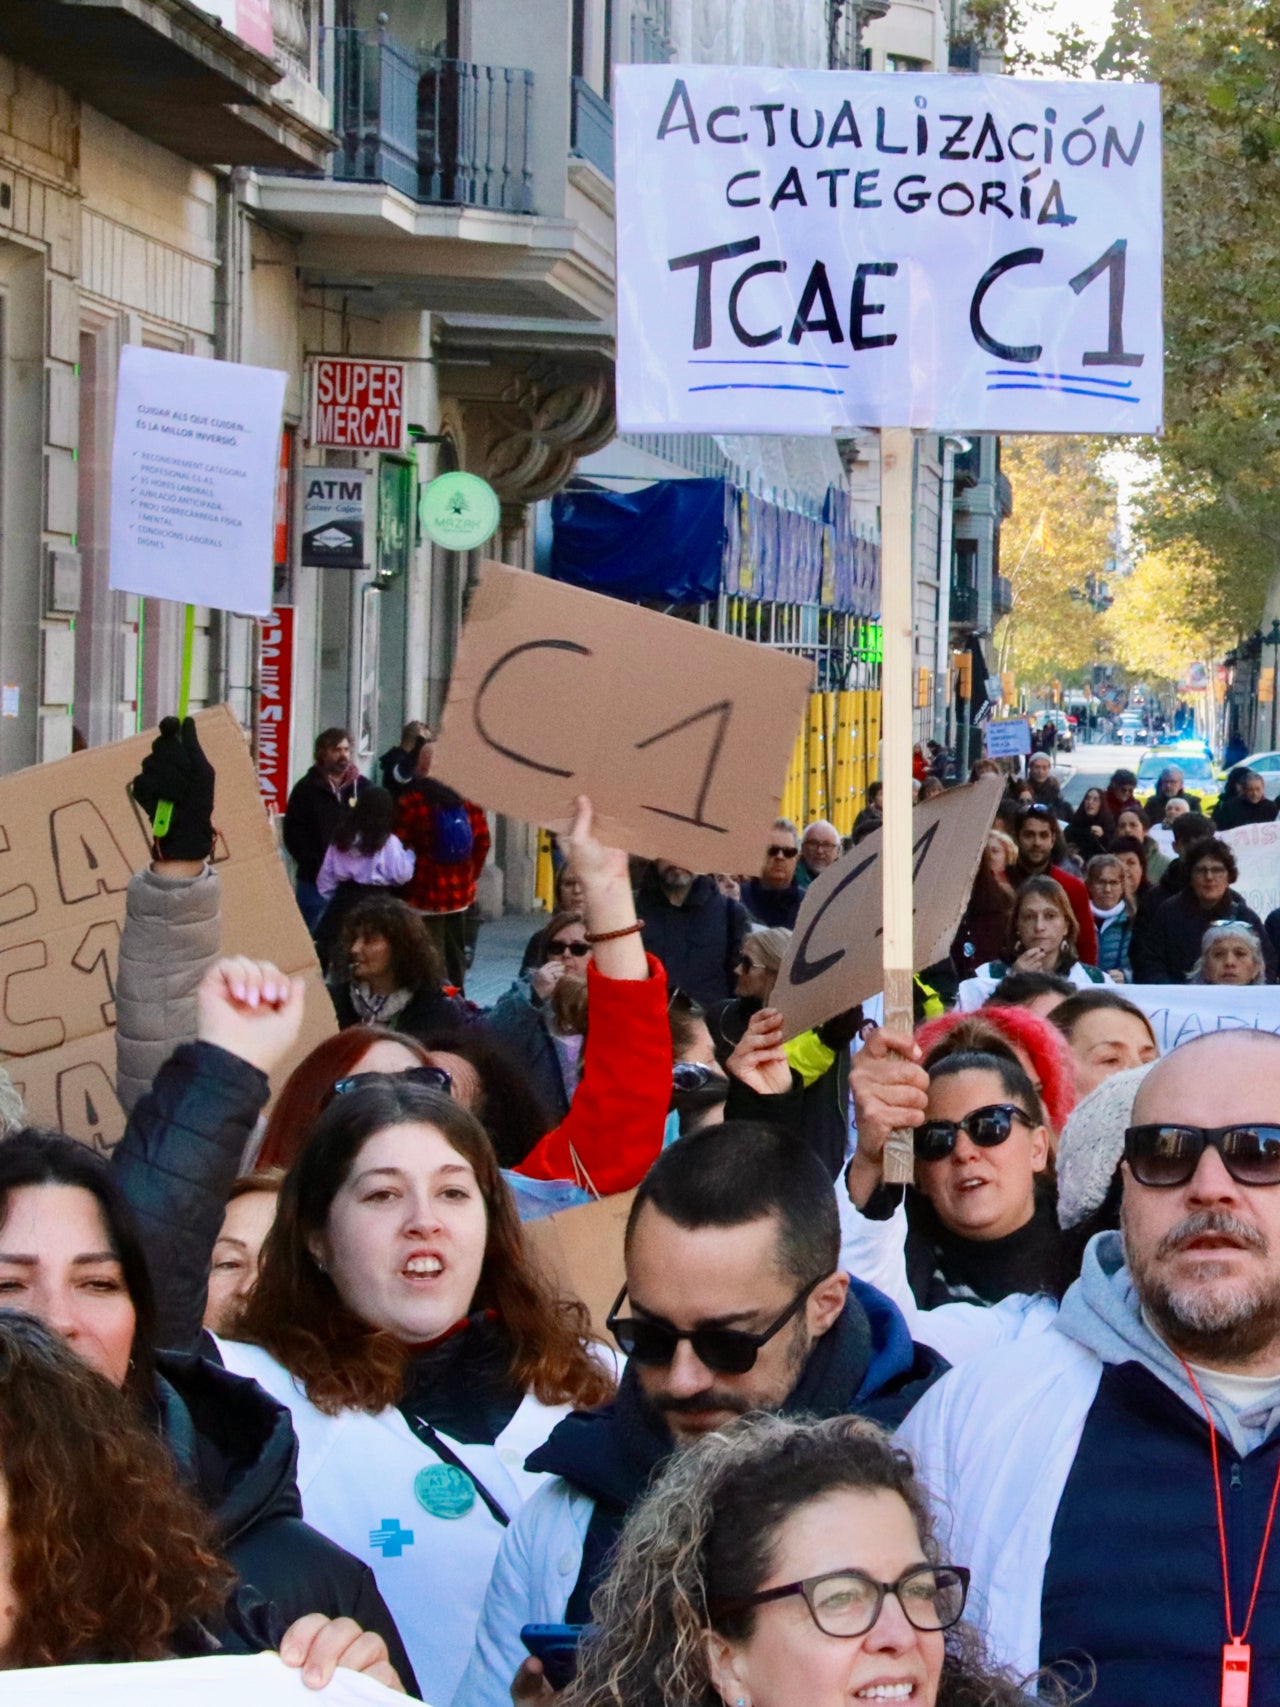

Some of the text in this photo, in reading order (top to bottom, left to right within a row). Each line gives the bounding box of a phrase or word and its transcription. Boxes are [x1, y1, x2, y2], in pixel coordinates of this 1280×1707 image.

[668, 234, 1144, 368] TCAE C1
[318, 364, 400, 406] SUPER
[317, 406, 400, 446] MERCAT
[307, 480, 363, 501] ATM
[475, 638, 732, 834] C1
